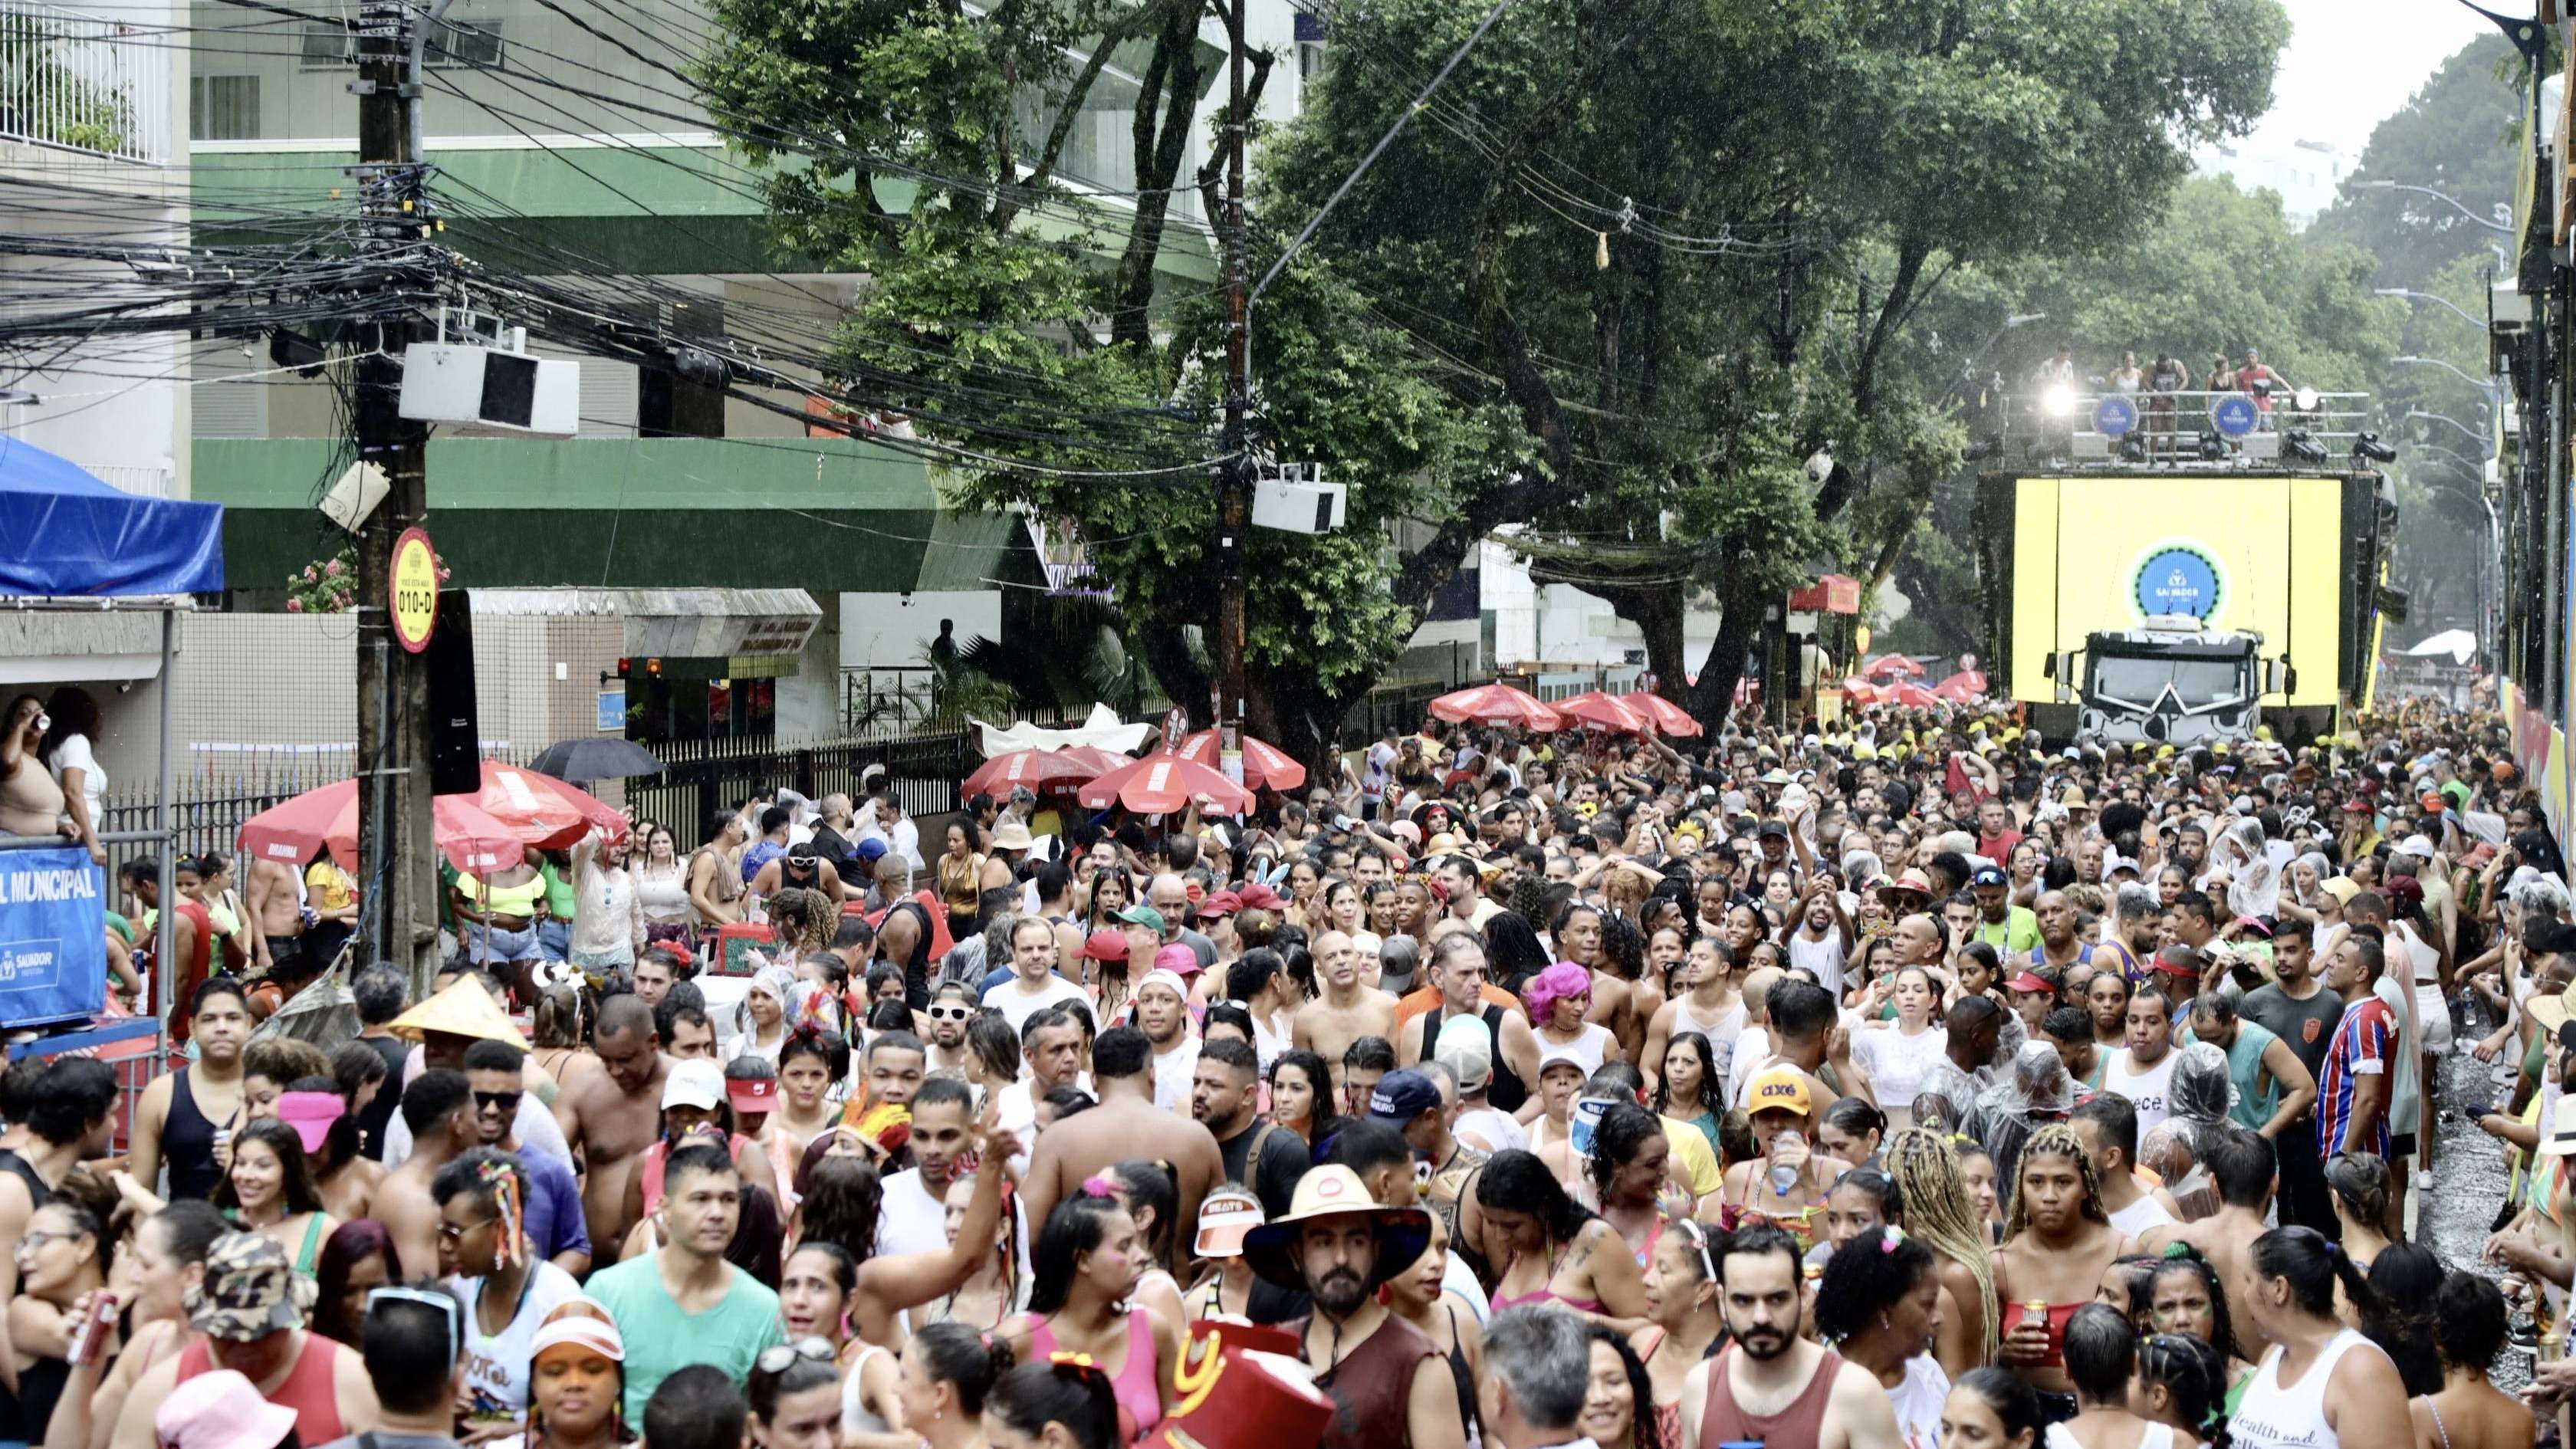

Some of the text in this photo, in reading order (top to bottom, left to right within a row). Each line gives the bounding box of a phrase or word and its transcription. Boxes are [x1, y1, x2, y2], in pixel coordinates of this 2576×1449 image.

[399, 590, 432, 614] 010-D
[268, 843, 297, 859] BRAHMA
[16, 951, 53, 968] SALVADOR
